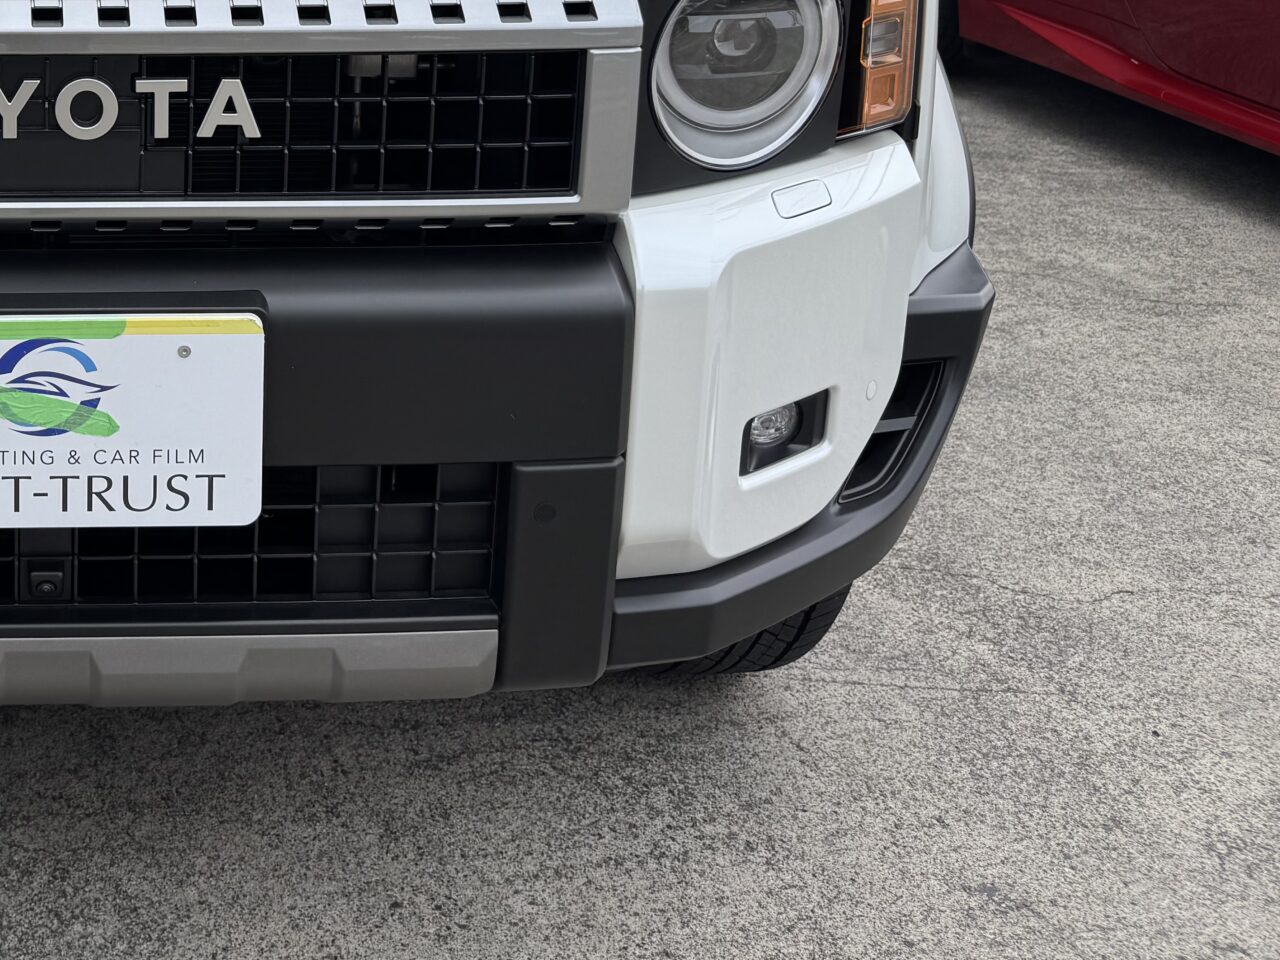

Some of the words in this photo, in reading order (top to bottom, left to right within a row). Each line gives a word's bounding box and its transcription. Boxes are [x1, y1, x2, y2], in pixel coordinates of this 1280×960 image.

[67, 449, 83, 466] &
[93, 448, 141, 465] CAR
[152, 448, 206, 465] FILM
